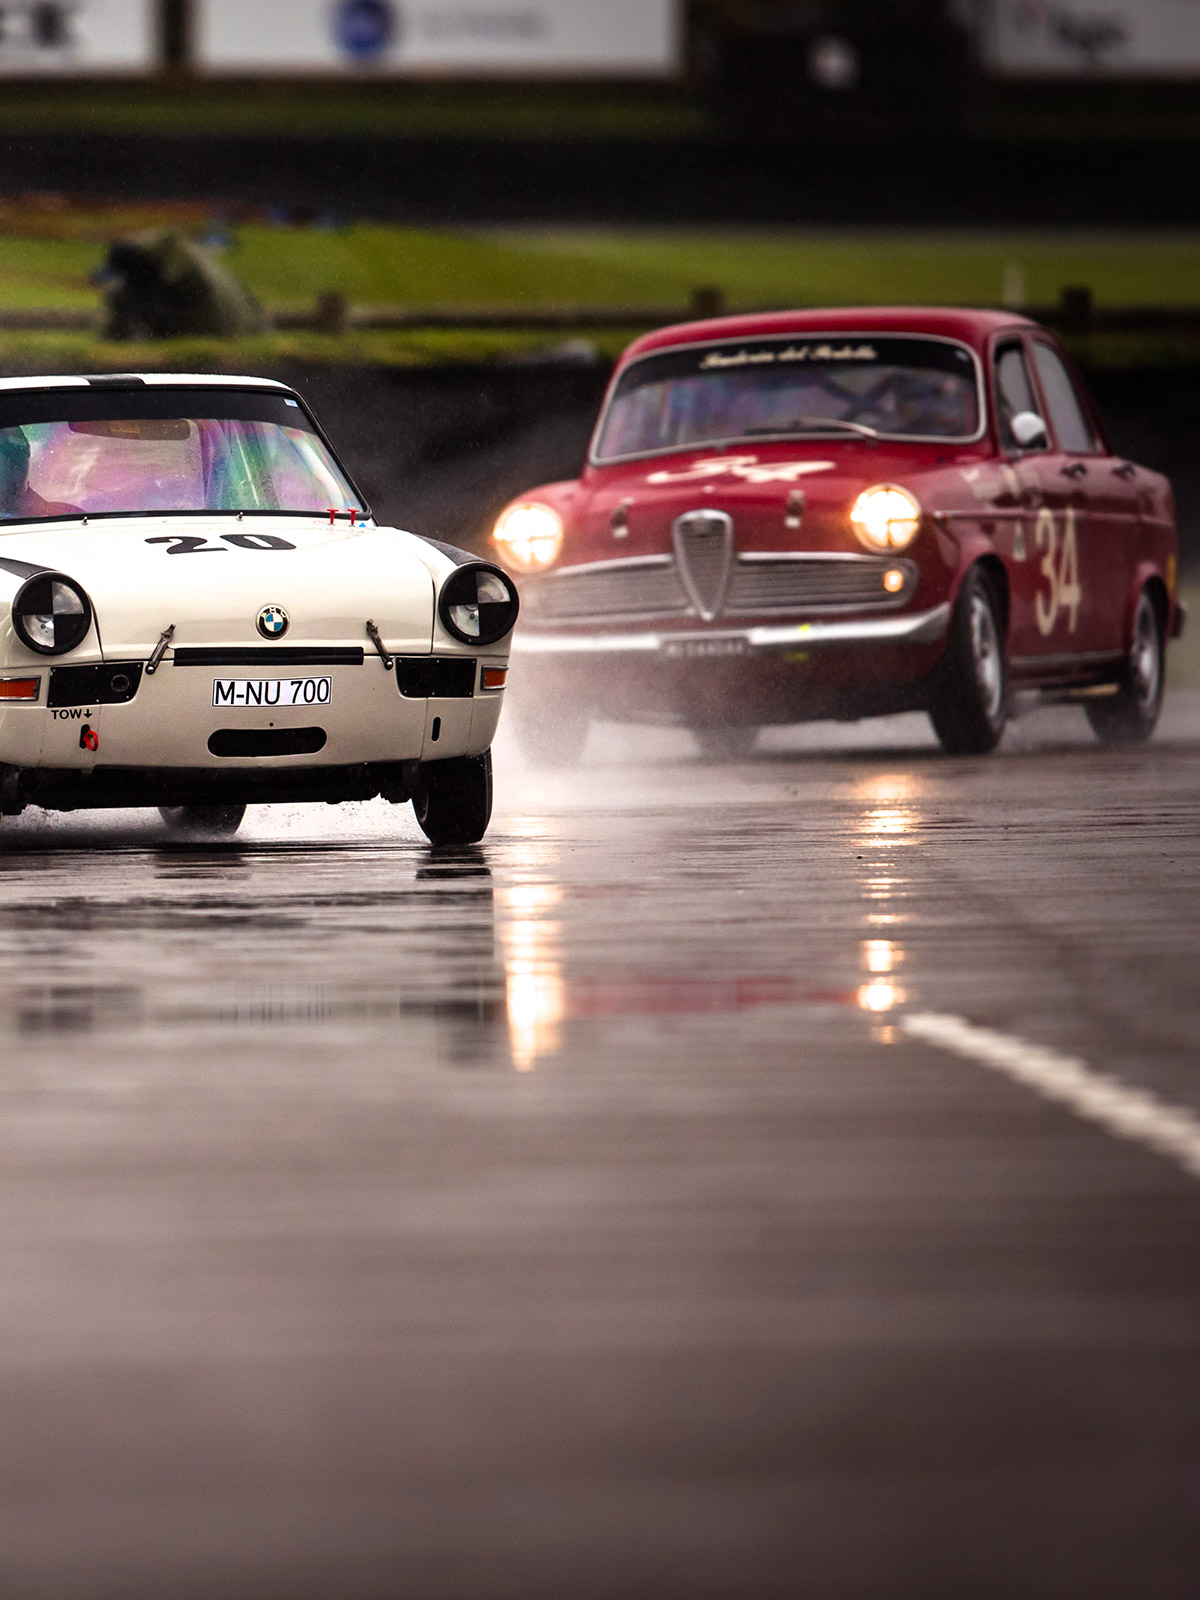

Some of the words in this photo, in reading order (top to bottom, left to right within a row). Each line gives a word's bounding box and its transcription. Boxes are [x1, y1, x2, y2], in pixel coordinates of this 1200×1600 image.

[144, 534, 297, 555] 20
[1035, 507, 1081, 637] 34
[215, 681, 280, 705] M-NU
[290, 679, 329, 703] 700
[51, 709, 82, 720] TOW
